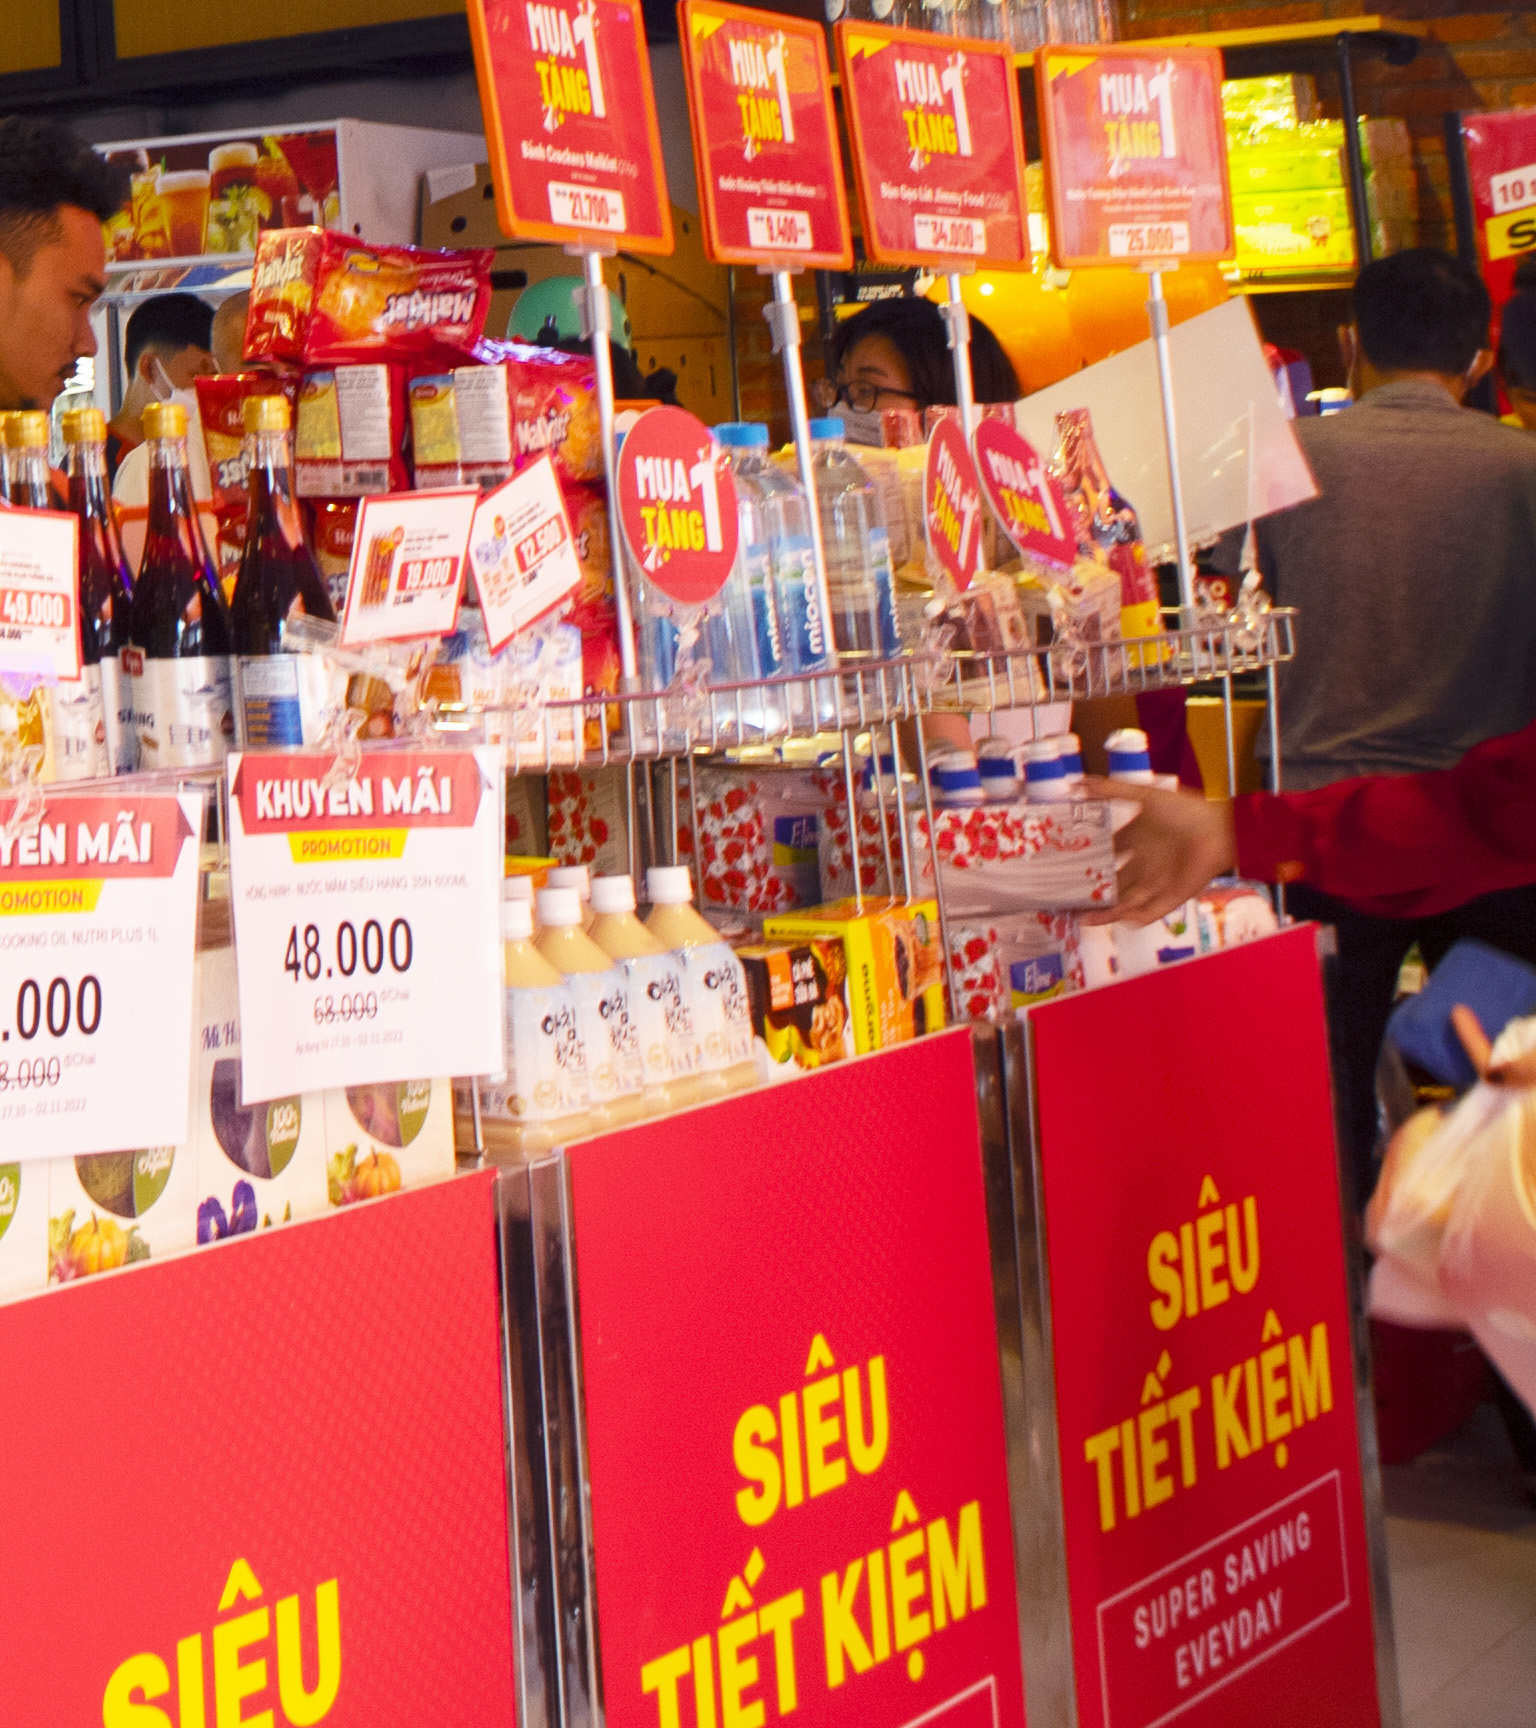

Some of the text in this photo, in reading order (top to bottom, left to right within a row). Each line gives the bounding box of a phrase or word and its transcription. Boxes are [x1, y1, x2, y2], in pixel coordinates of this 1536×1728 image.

[526, 1, 576, 59] MUA
[535, 54, 591, 126] TẶNG
[729, 38, 770, 90] MUA
[894, 59, 944, 107] MUA
[737, 88, 783, 153] TẶNG
[1099, 74, 1149, 115] MUA
[902, 104, 958, 166] TẶNG
[1104, 114, 1161, 171] TẶNG
[382, 288, 477, 330] Malkist
[634, 455, 691, 502] MUA
[519, 519, 562, 572] 12.500
[640, 499, 705, 563] TẶNG
[406, 560, 451, 589] 19.000
[3, 591, 64, 627] 49.000
[381, 767, 452, 814] MÃI
[77, 810, 153, 863] MÃI
[301, 836, 392, 856] PROMOTION
[50, 929, 70, 947] OIL
[72, 927, 108, 946] NUTRI
[111, 927, 143, 943] PLUS
[284, 917, 413, 983] 48.000
[314, 991, 378, 1025] 68.000
[1146, 1174, 1261, 1332] SIÊU
[731, 1334, 891, 1527] SIÊU
[1083, 1308, 1334, 1534] TIẾT KIỆM
[640, 1488, 989, 1728] TIẾT KIỆM
[1133, 1510, 1312, 1651] SUPER SAVING
[1174, 1590, 1285, 1690] EVEYDAY
